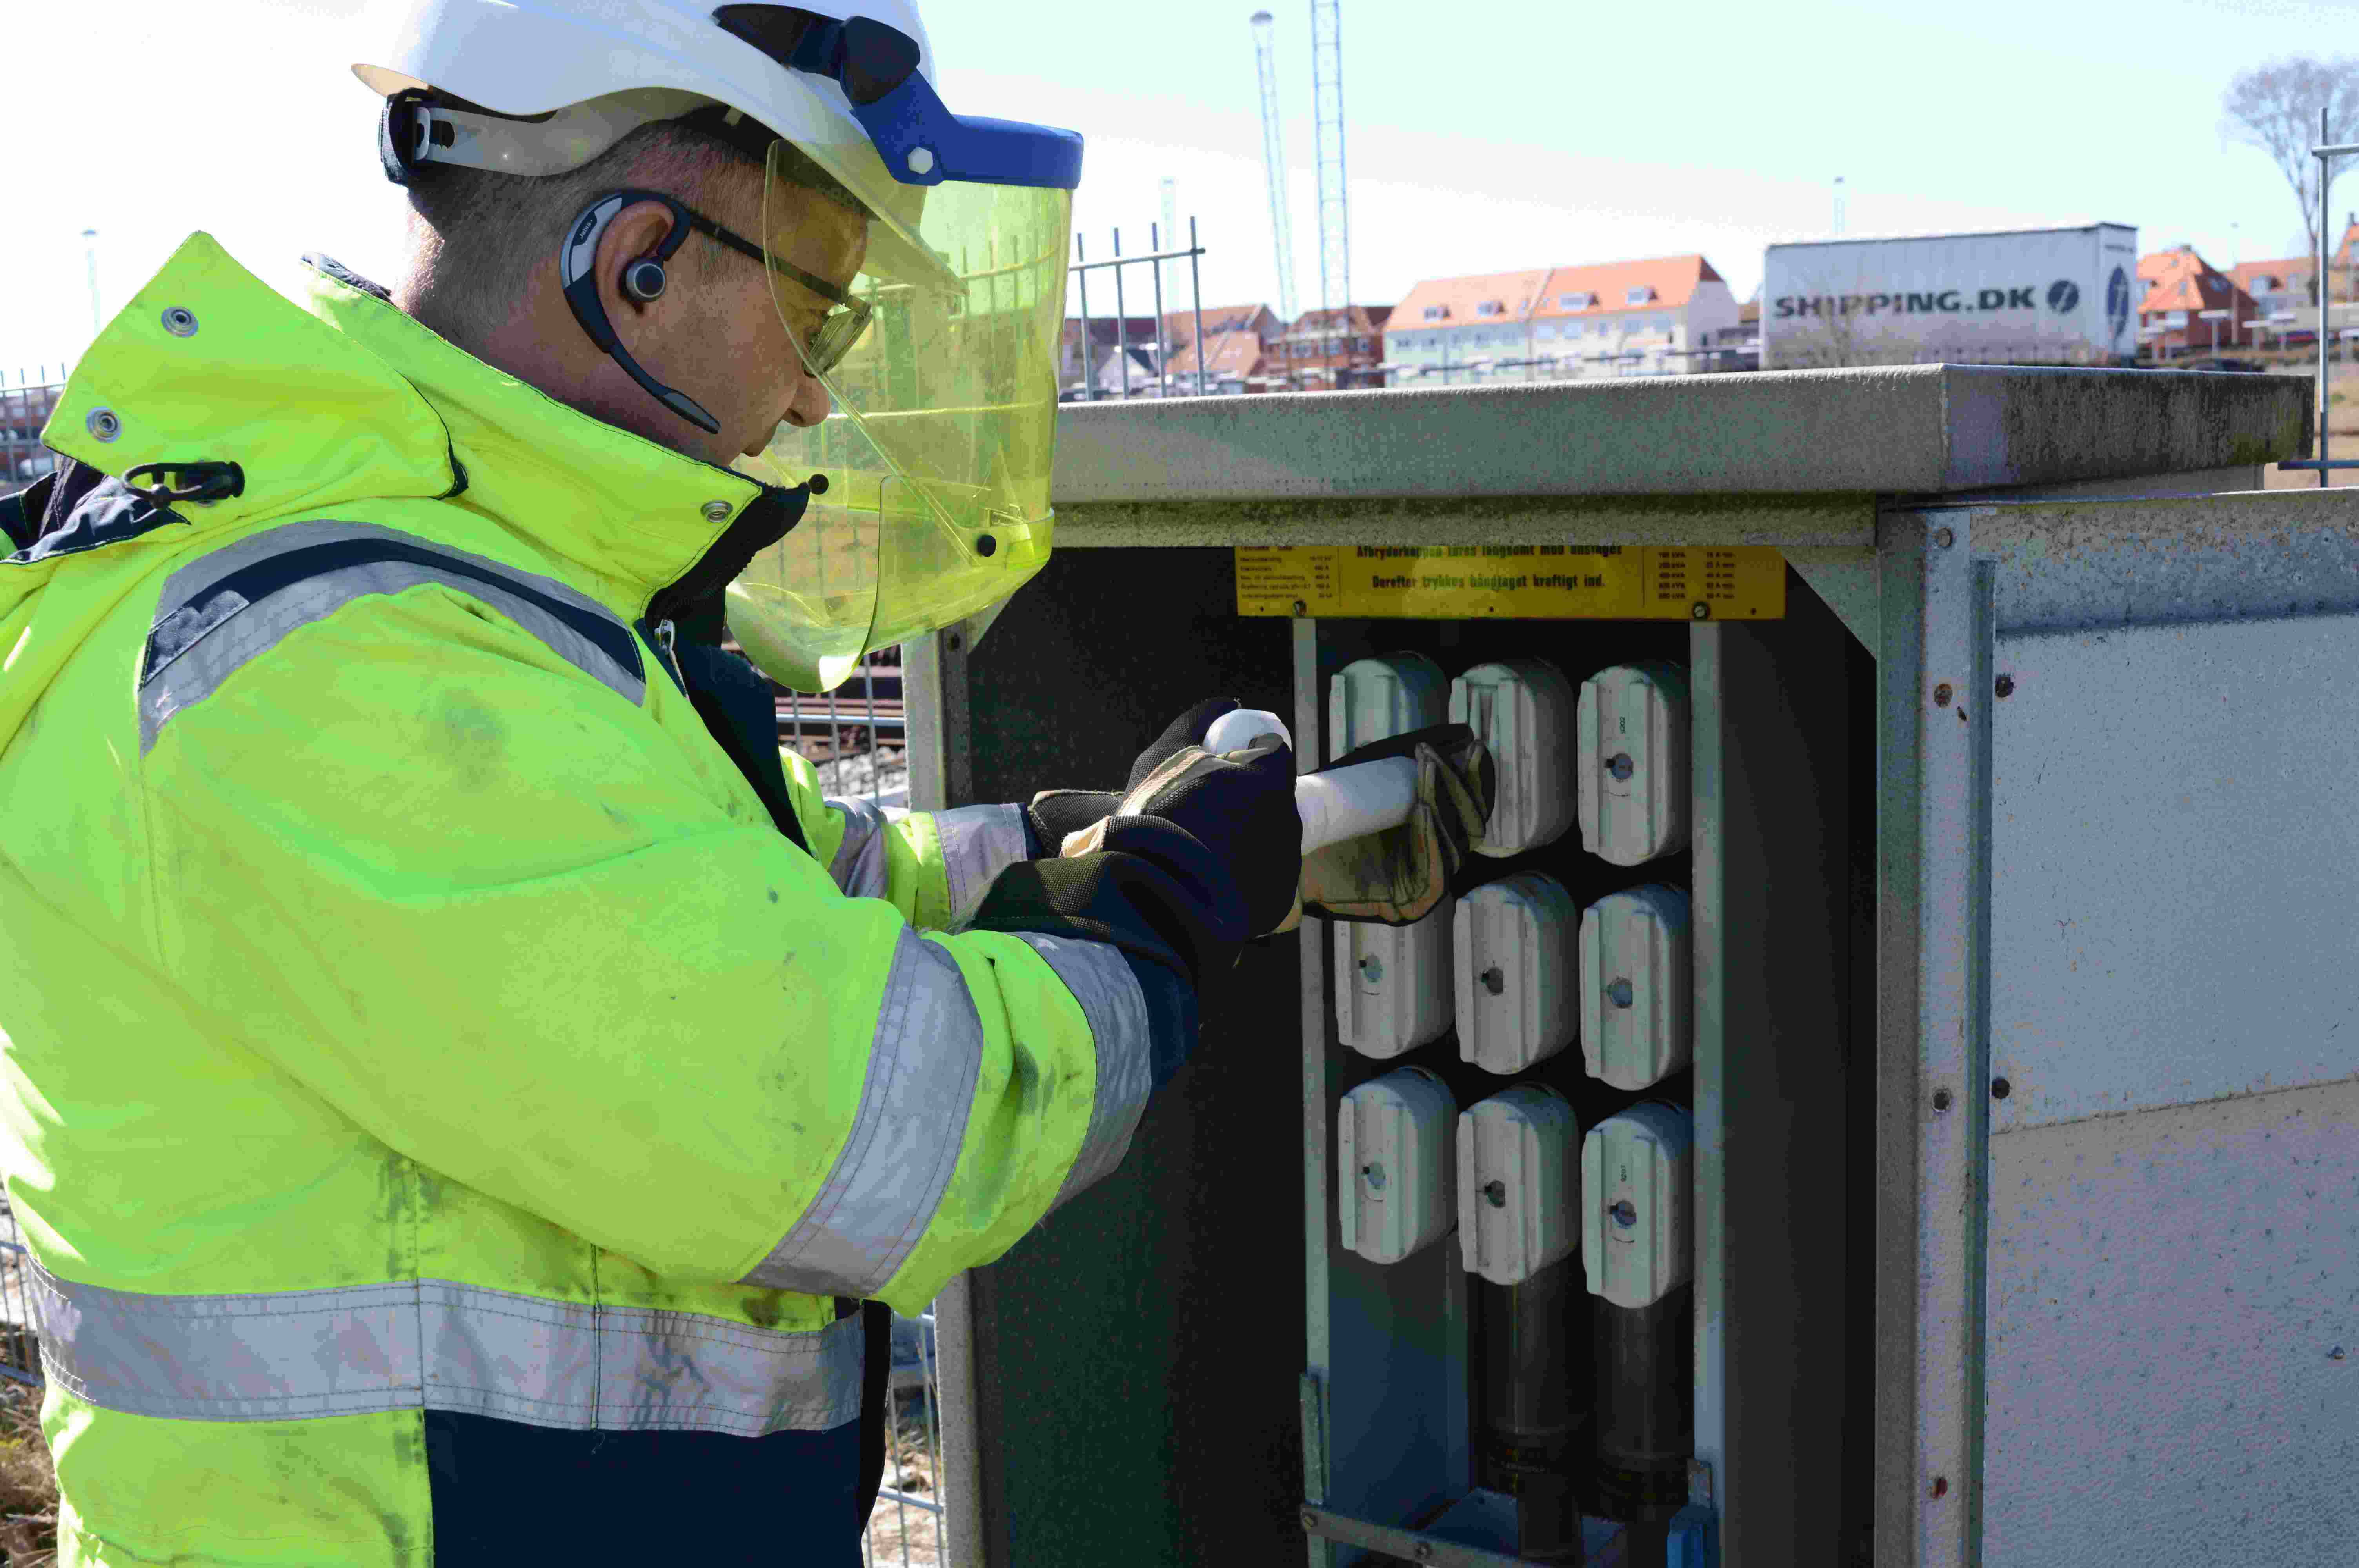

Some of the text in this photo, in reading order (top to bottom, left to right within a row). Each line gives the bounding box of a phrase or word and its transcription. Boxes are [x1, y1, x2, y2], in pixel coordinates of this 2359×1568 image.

[1774, 286, 2036, 318] SHIPPING.DK
[1372, 575, 1417, 588] Derefter
[1422, 574, 1464, 590] trykkes
[1533, 574, 1577, 590] kraftigt
[1584, 574, 1606, 587] ind.
